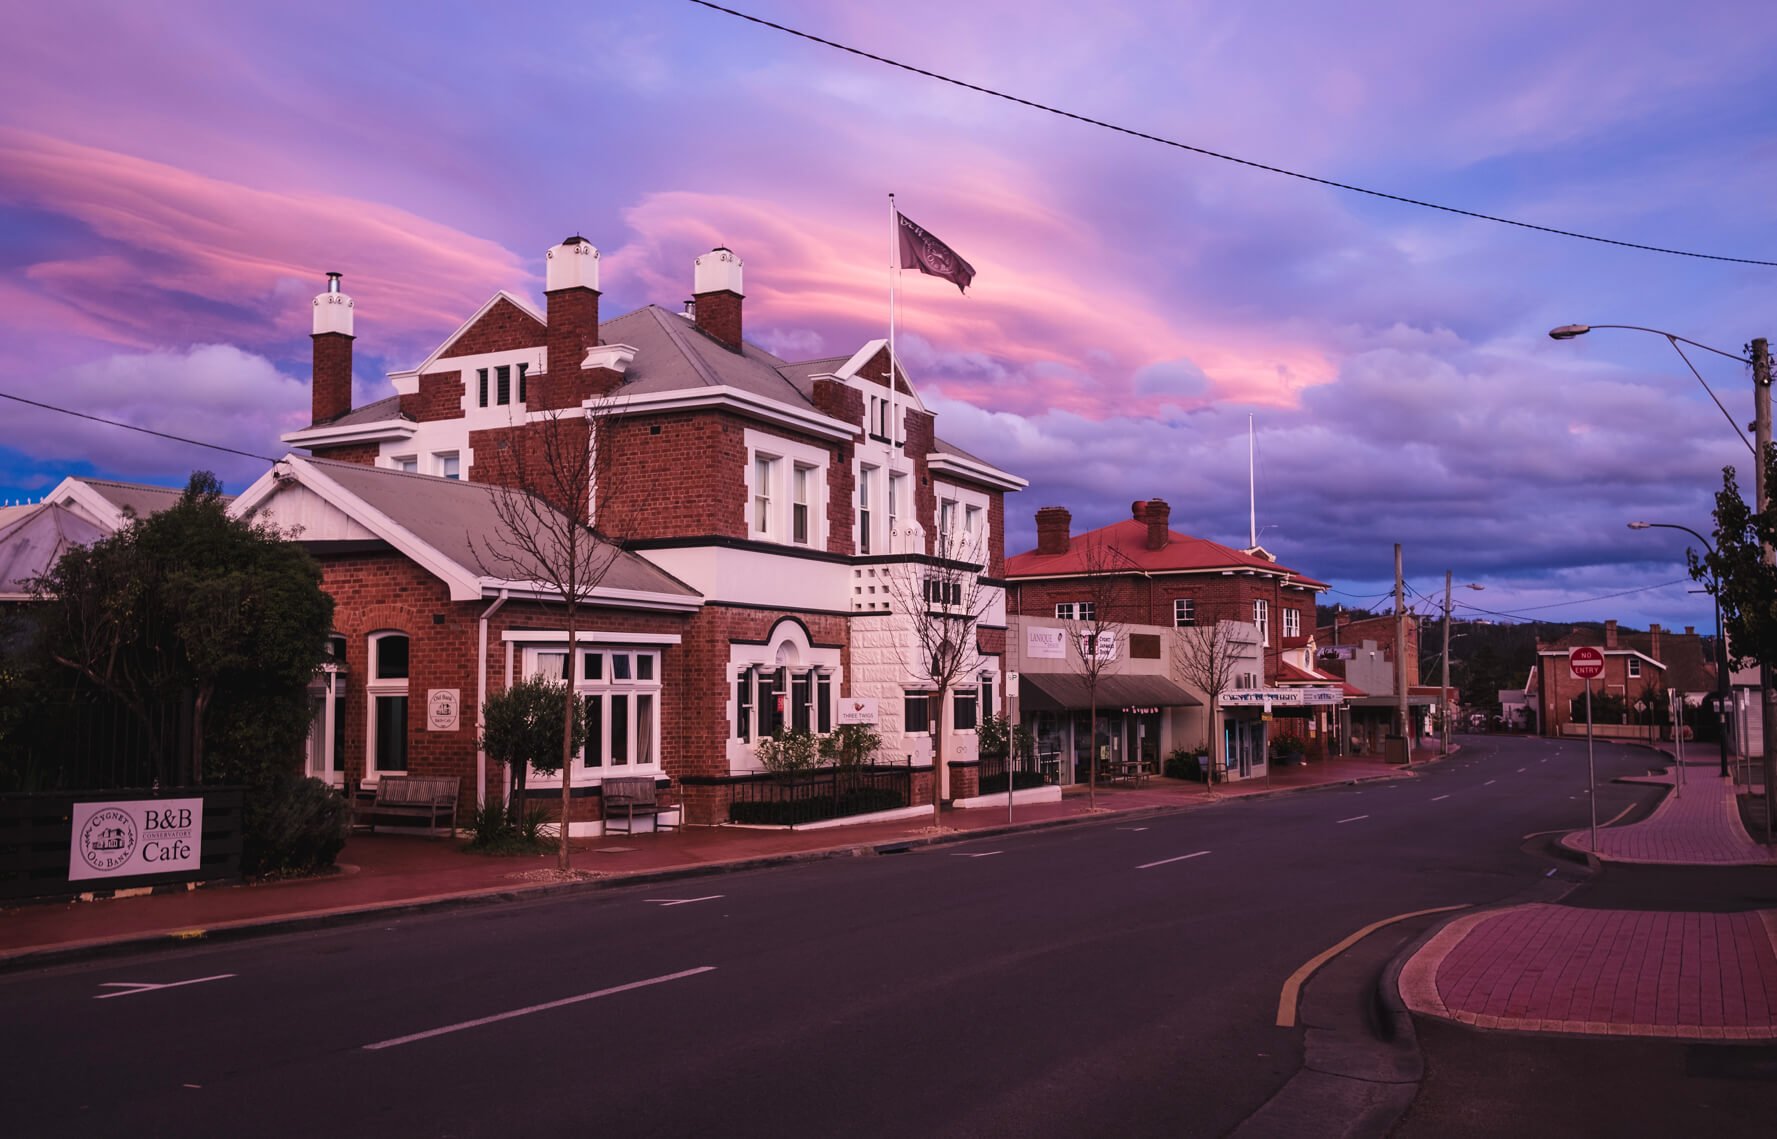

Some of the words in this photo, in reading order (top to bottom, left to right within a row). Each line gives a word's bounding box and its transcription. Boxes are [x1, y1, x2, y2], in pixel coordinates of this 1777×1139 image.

[1030, 632, 1053, 644] LANIQUE
[92, 811, 129, 827] CYGNET
[145, 808, 192, 830] B&B
[142, 831, 191, 840] CONSERVATORY
[143, 839, 191, 862] Cafe
[87, 851, 104, 867] OLD
[107, 851, 129, 867] BANK
